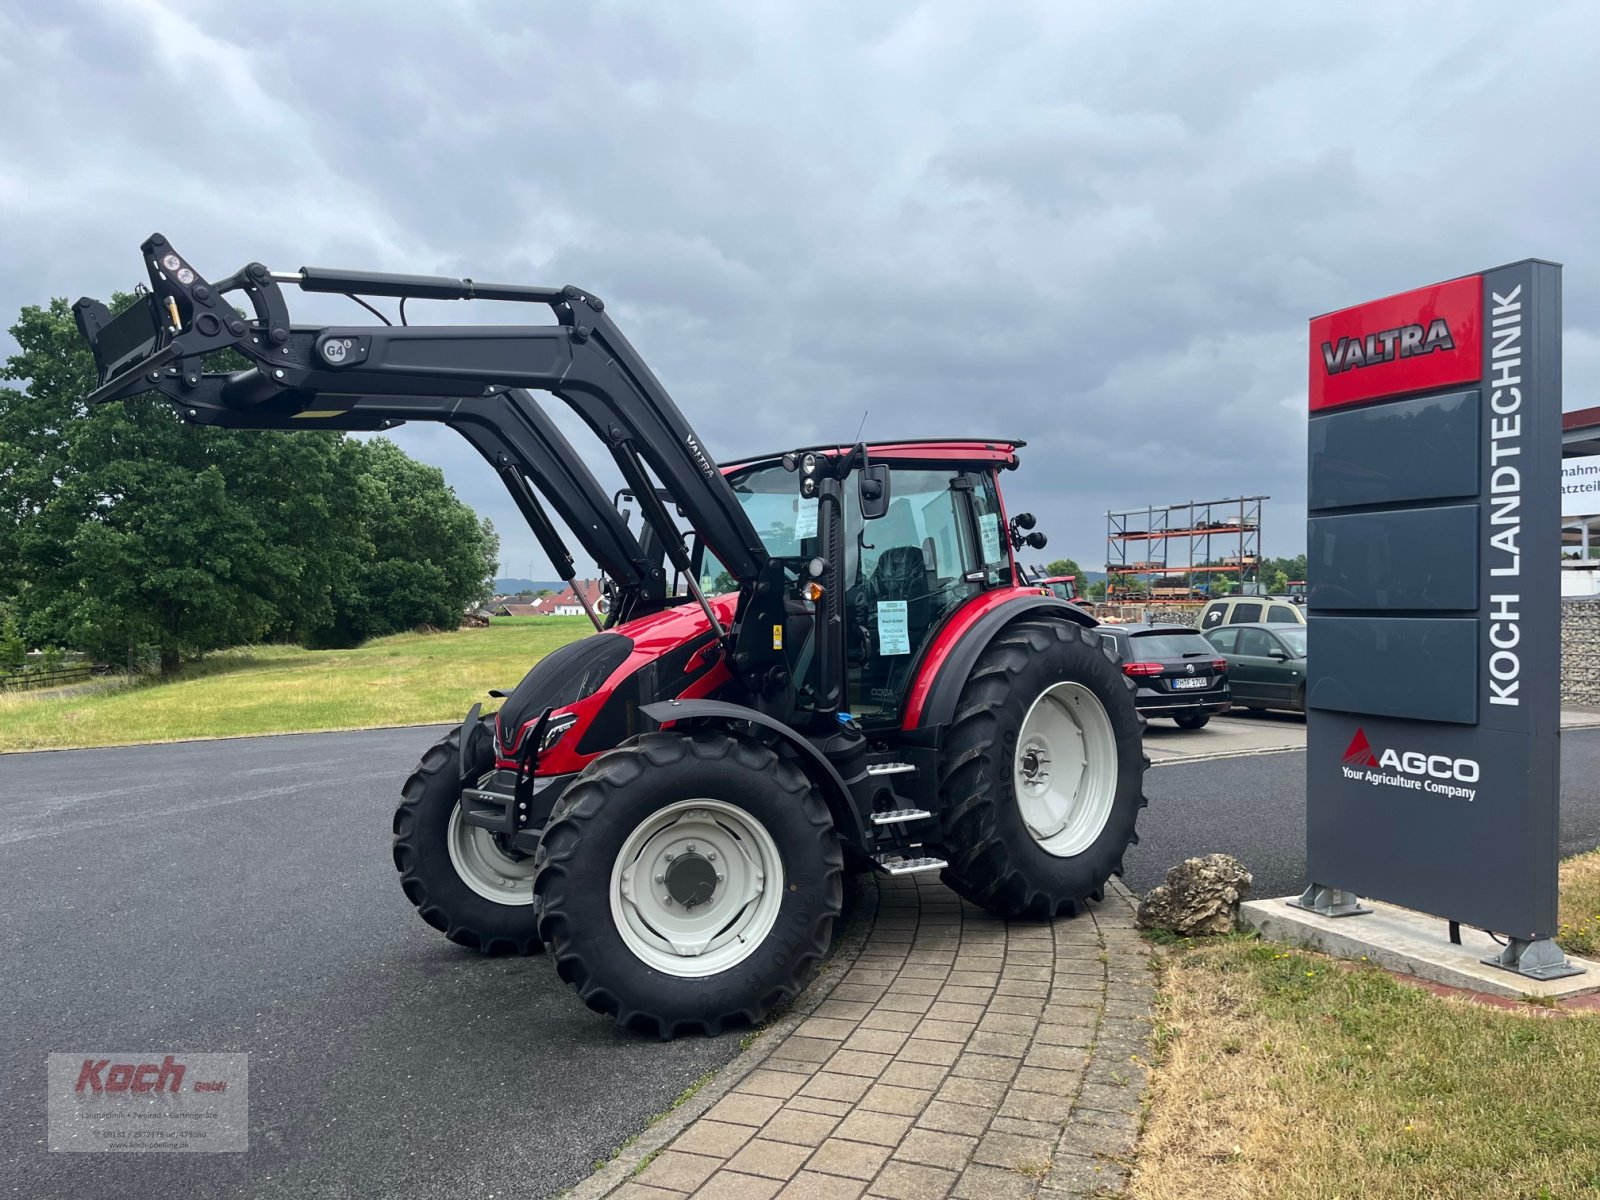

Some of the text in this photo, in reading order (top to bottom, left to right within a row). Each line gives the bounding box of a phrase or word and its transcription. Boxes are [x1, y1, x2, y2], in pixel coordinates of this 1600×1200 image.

[327, 346, 343, 356] G4
[1321, 318, 1455, 375] VALTRA
[685, 433, 714, 480] VALTRA
[1561, 465, 1600, 477] nahm
[1489, 283, 1522, 706] KOCH LANDTECHNIK
[1379, 748, 1480, 783] AGCO
[1342, 766, 1476, 802] Your Agriculture Company
